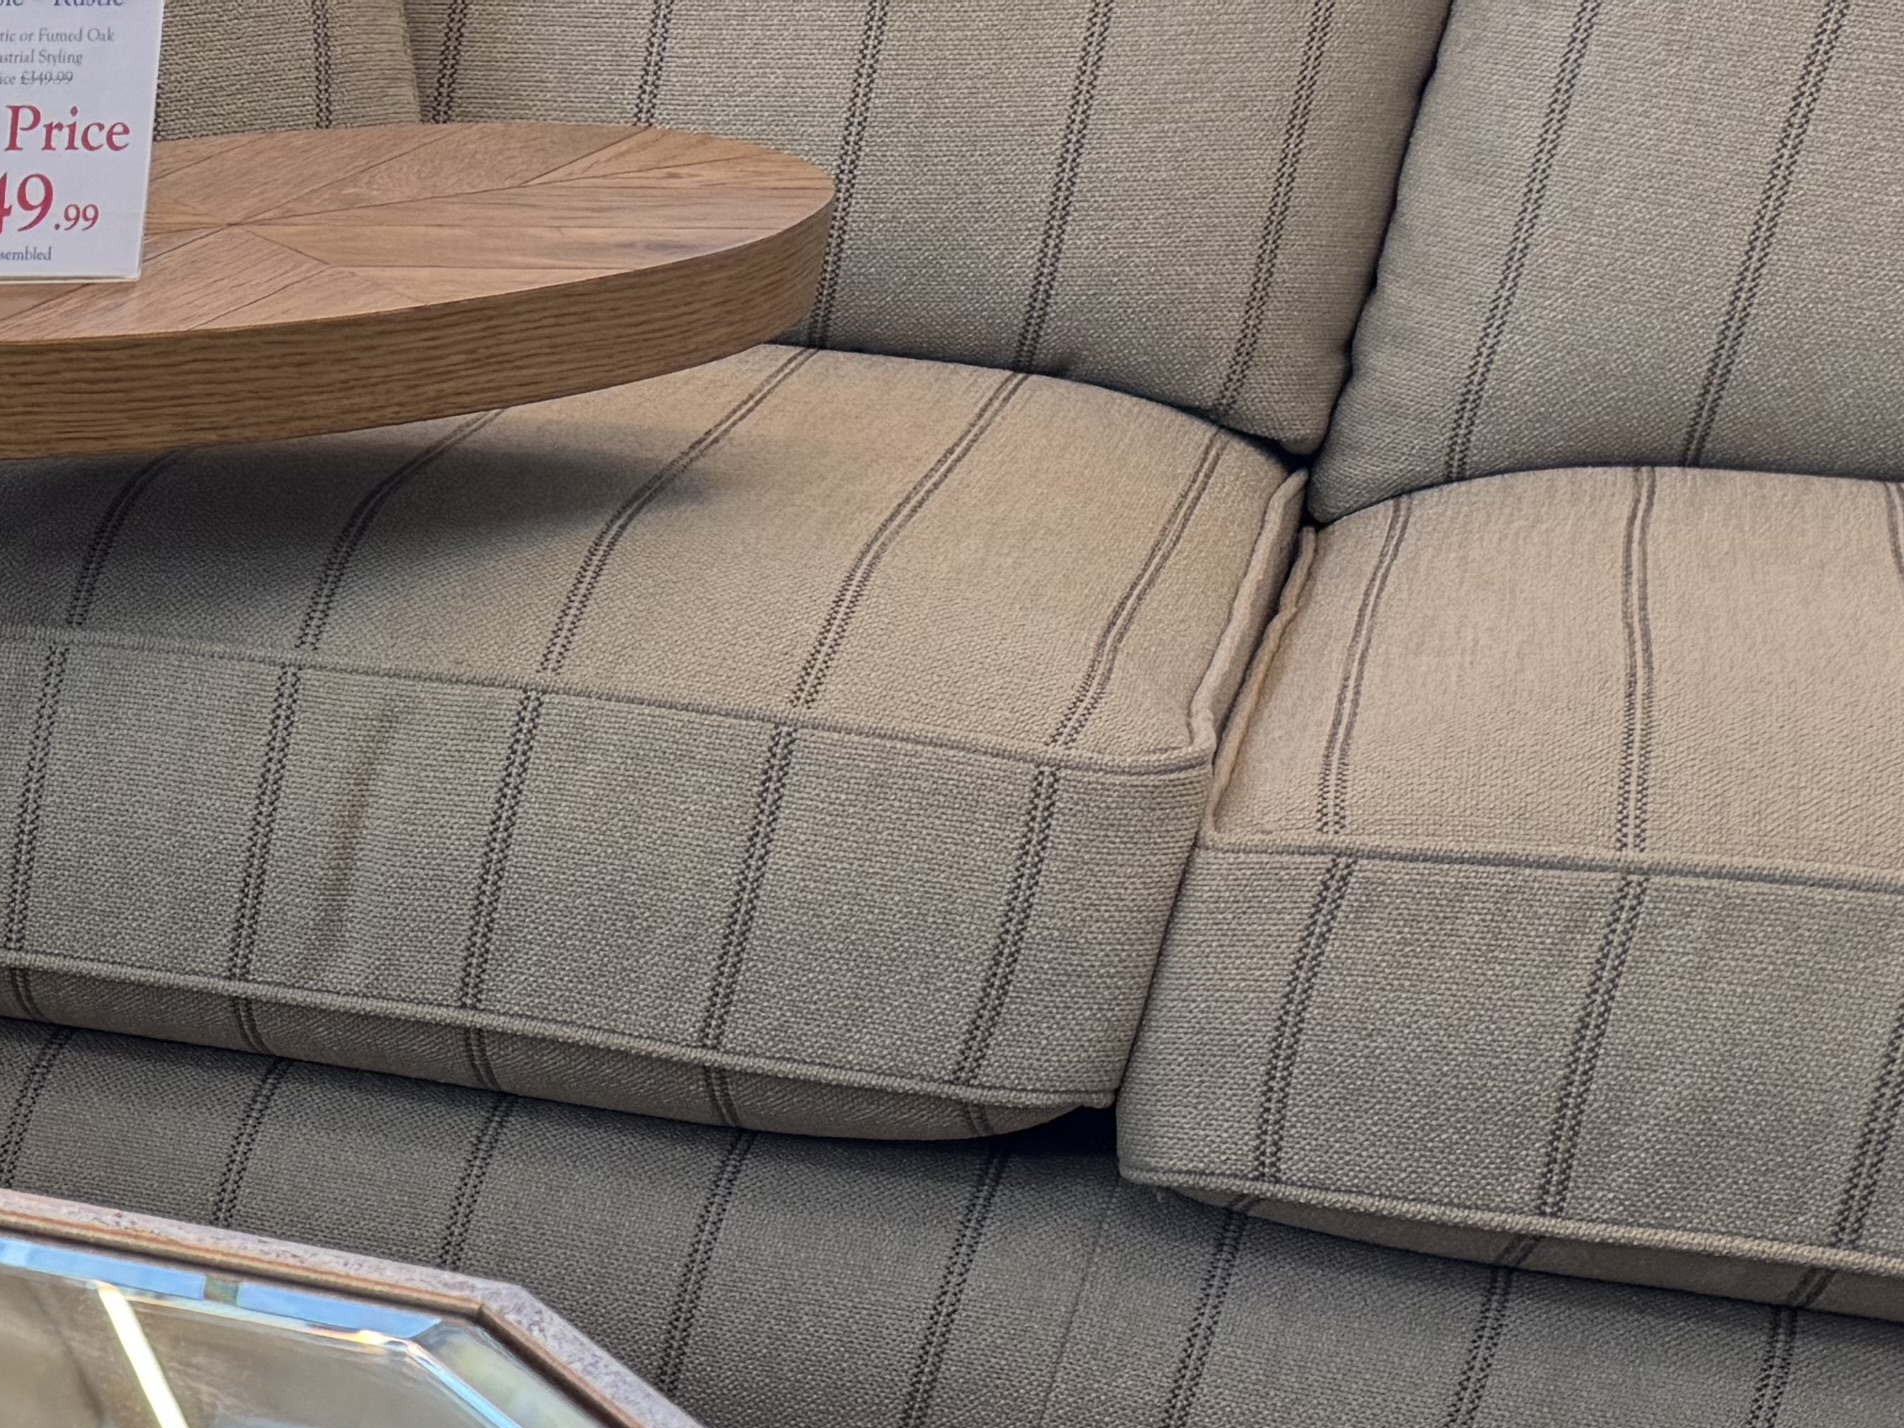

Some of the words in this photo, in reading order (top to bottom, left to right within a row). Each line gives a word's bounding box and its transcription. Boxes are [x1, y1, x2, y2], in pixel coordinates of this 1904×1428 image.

[20, 32, 35, 42] or
[38, 27, 83, 43] Fumed
[87, 27, 115, 42] Oak
[38, 50, 84, 66] Styling
[4, 104, 130, 152] Price
